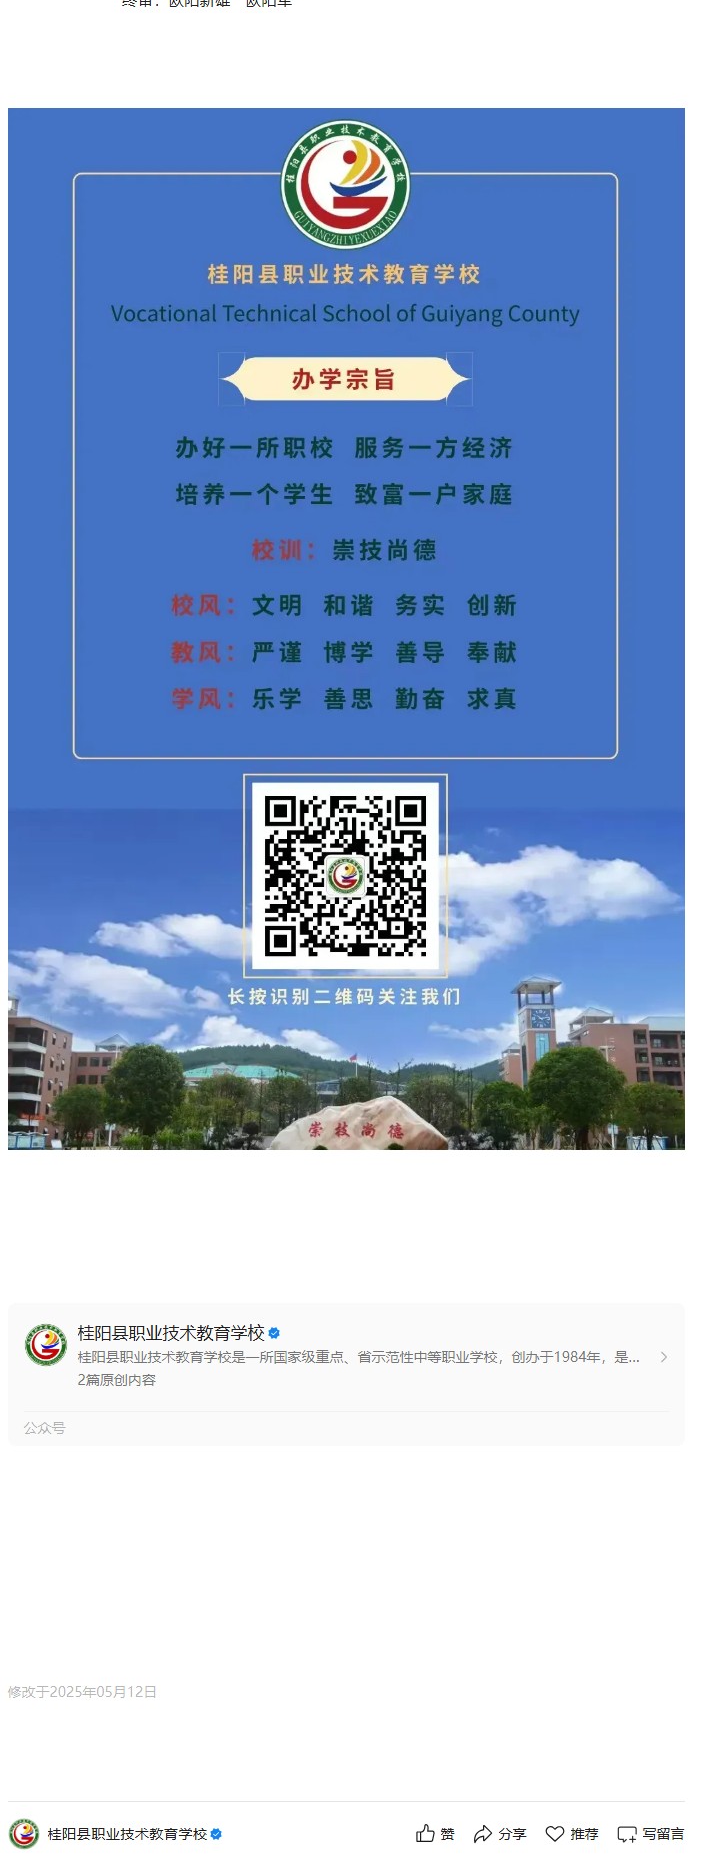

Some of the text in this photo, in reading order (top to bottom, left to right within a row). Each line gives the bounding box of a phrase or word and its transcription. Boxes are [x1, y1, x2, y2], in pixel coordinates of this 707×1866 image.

[293, 210, 397, 246] GUIYANGZHIYEXUEXIAO
[207, 264, 480, 285] 桂阳县职业技术教育学校
[112, 304, 580, 328] Vocational Technical School of Guiyang County
[292, 368, 396, 391] 办学宗旨
[176, 436, 512, 459] 办好一所职校 服务一方经济
[176, 482, 512, 505] 培养一个学生 致富一户家庭
[324, 594, 373, 617] 和谐
[396, 594, 445, 617] 务实
[467, 594, 516, 617] 创新
[324, 641, 373, 664] 博学
[396, 641, 445, 664] 善导
[467, 641, 516, 664] 奉献
[324, 687, 373, 710] 善思
[396, 687, 445, 710] 勤奋
[467, 687, 516, 710] 求真
[227, 987, 460, 1006] 长按识别二维码关注我们
[309, 1121, 404, 1139] 崇技尚德
[78, 1324, 265, 1341] 桂阳县职业技术教育学校
[78, 1373, 156, 1386] 2篇原创内容
[24, 1422, 66, 1435] 公众号
[8, 1685, 157, 1699] 修改于2025年05月12日
[47, 1827, 208, 1841] 桂阳县职业技术教育学校
[441, 1827, 455, 1841] 赞
[499, 1827, 527, 1841] 分享
[571, 1827, 600, 1841] 推荐
[643, 1827, 685, 1841] 写留言
